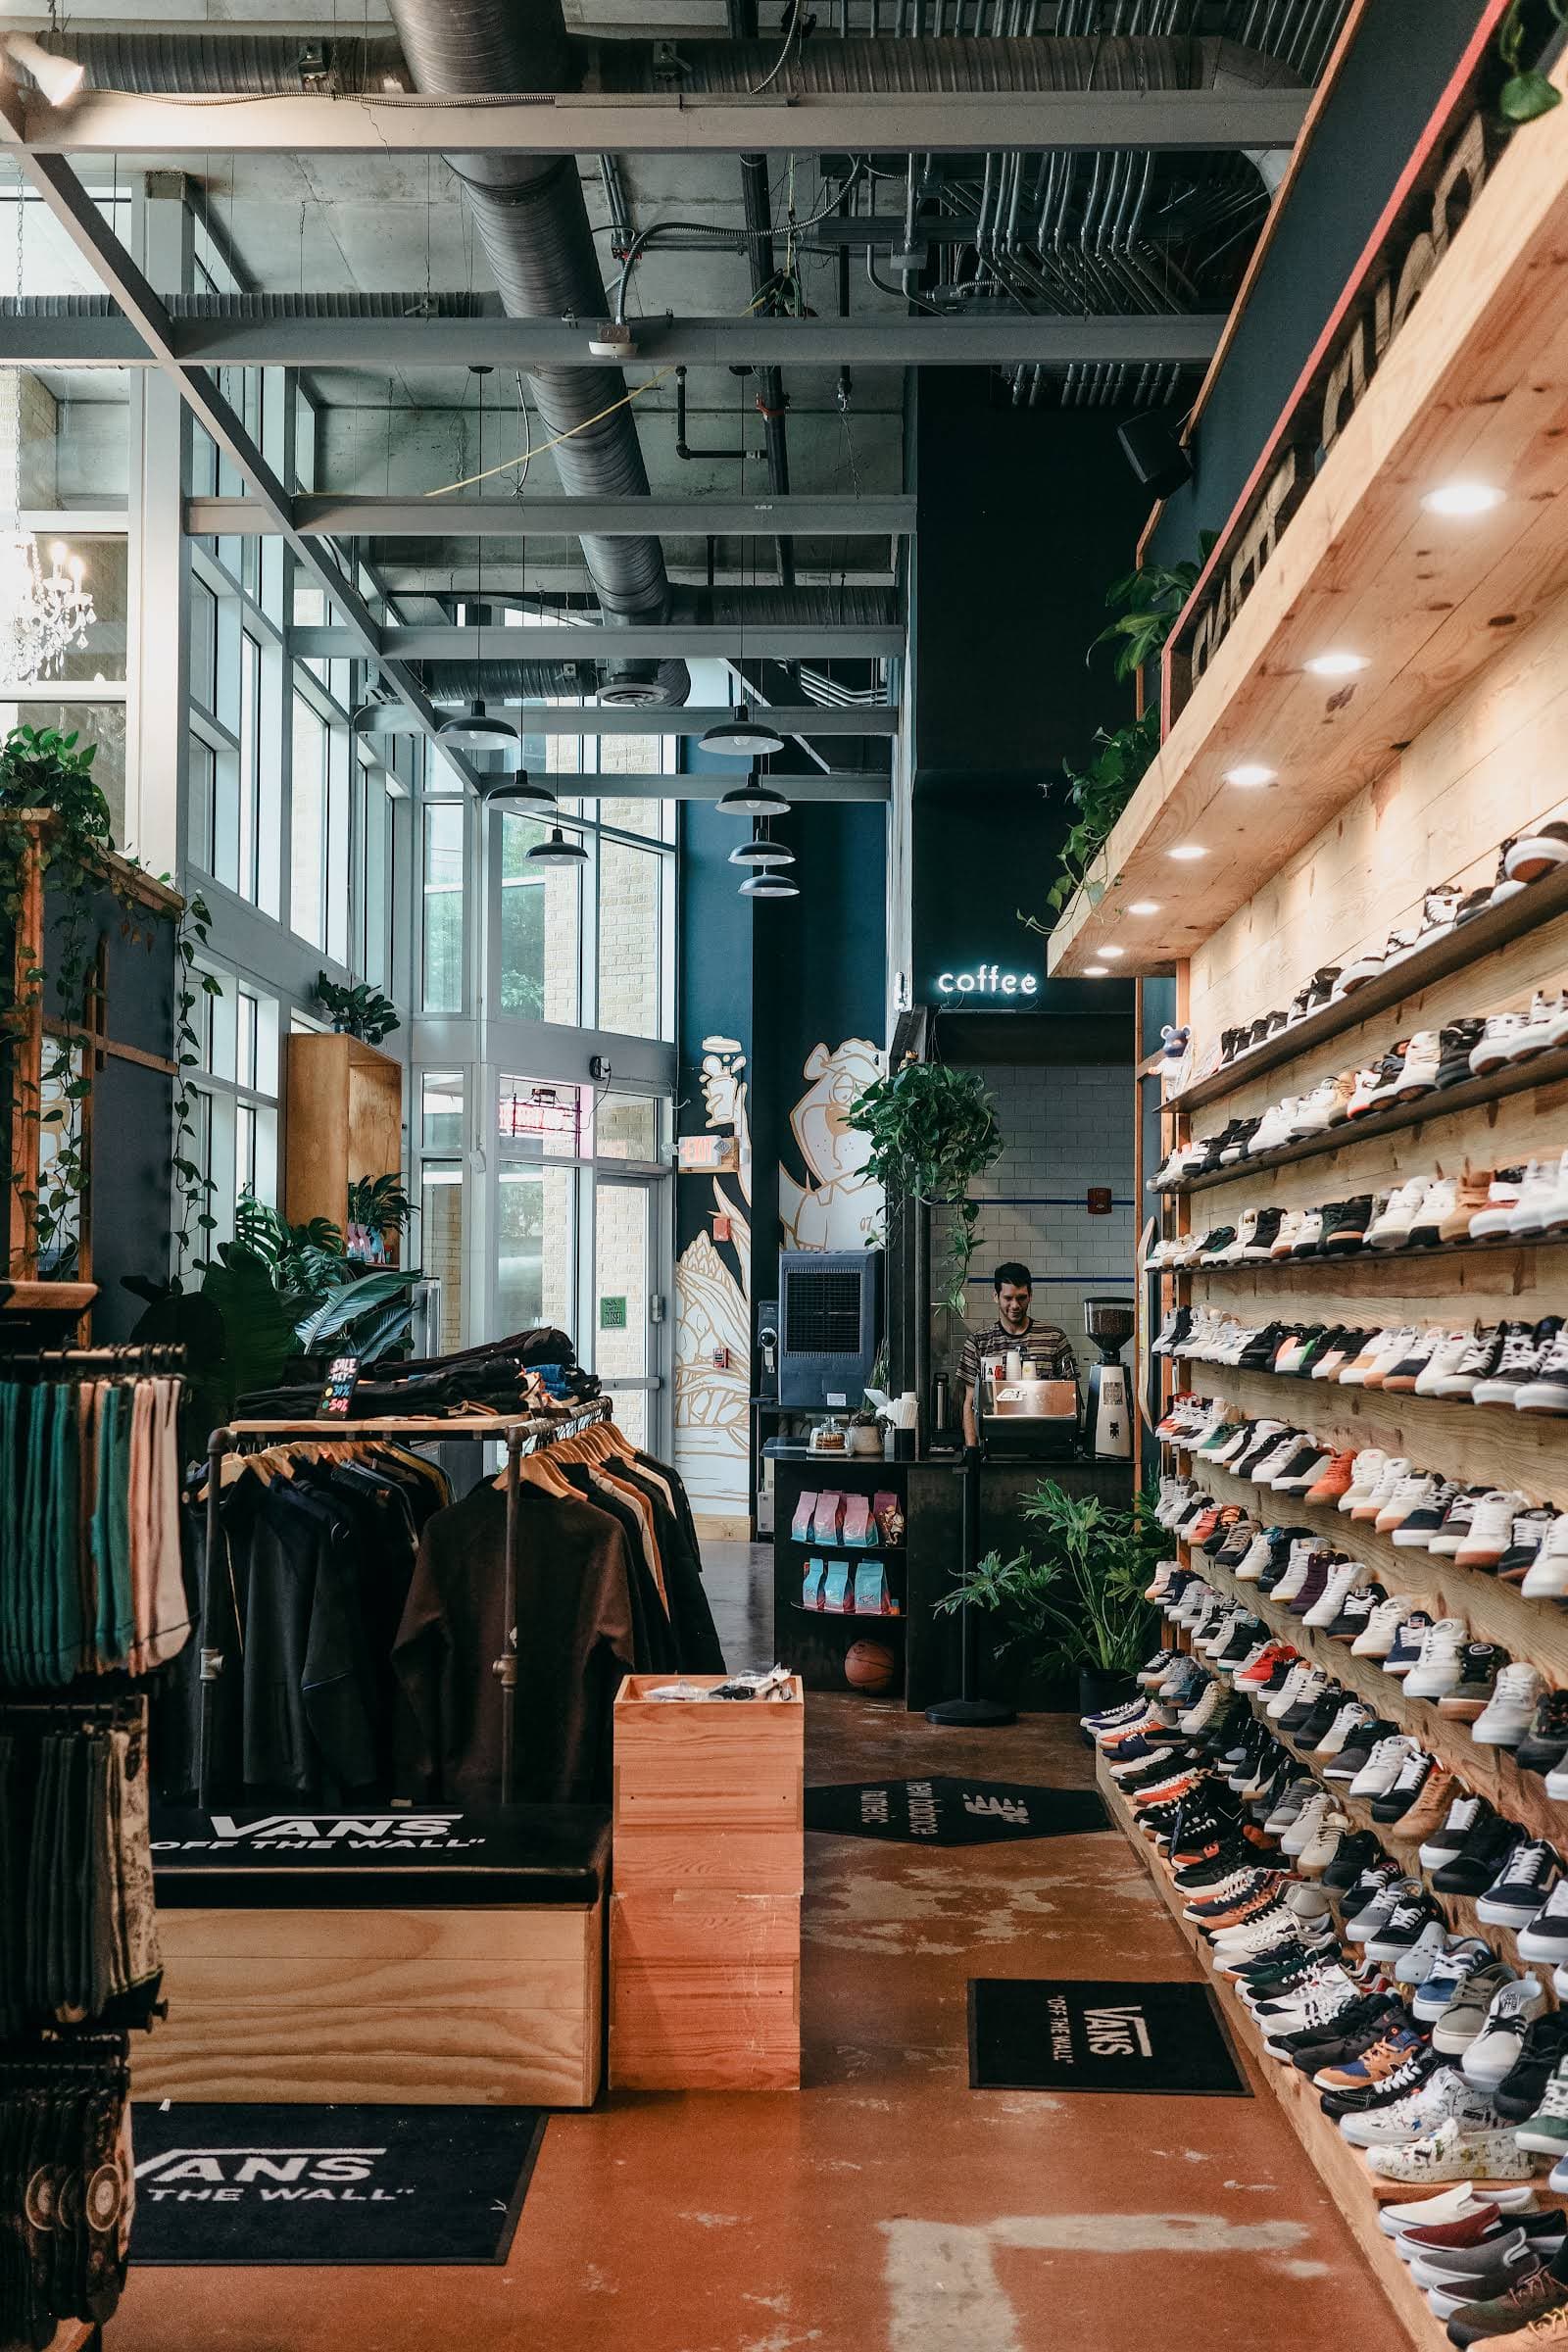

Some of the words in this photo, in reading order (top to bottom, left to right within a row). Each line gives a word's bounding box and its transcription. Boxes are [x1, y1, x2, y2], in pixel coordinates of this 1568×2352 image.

[938, 964, 1038, 994] coffee
[330, 1357, 357, 1373] SALE
[860, 1790, 897, 1824] numeric
[907, 1798, 944, 1836] balance
[210, 1813, 464, 1838] VANS
[149, 1840, 239, 1850] OFF
[250, 1839, 337, 1850] THE
[1050, 2017, 1071, 2034] THE
[1083, 2005, 1152, 2057] VANS
[147, 2187, 244, 2202] THE
